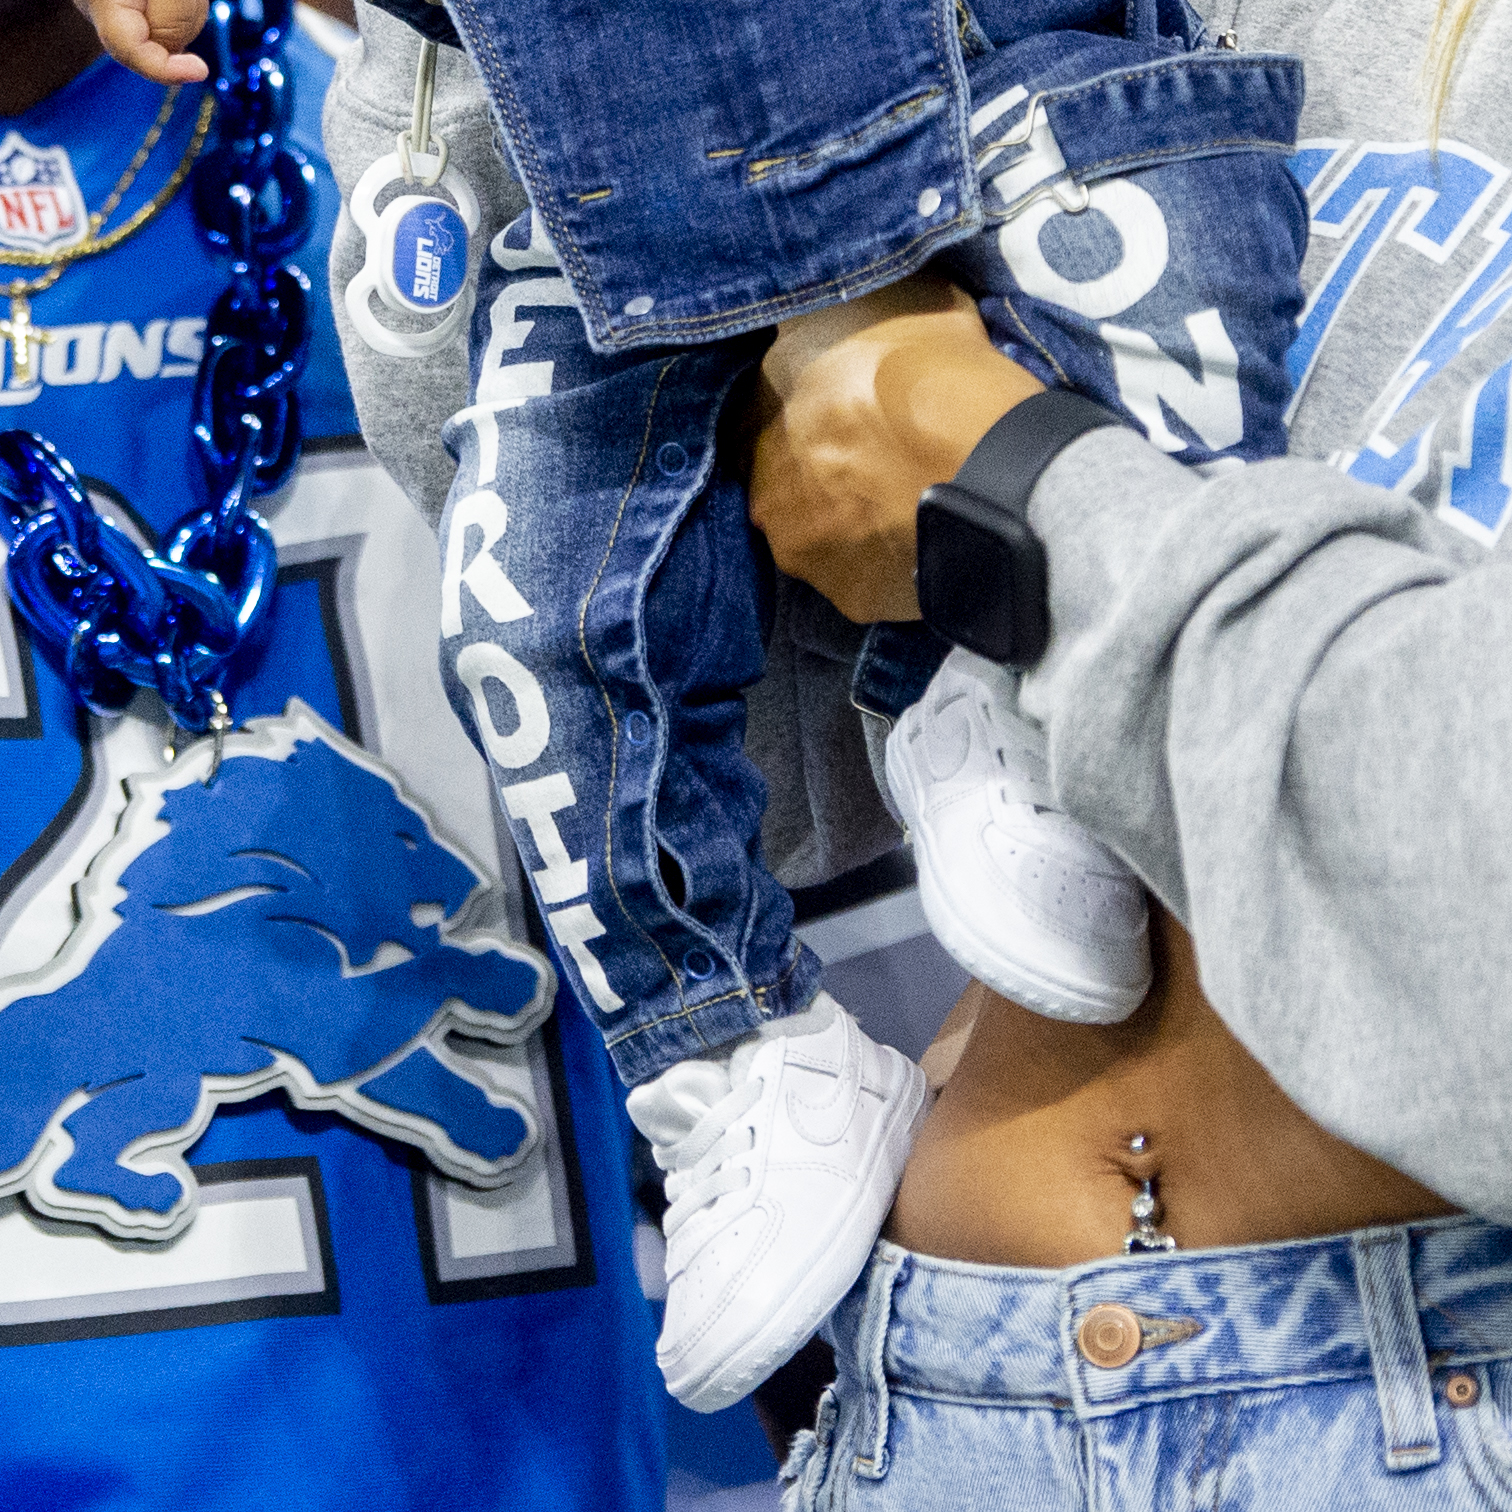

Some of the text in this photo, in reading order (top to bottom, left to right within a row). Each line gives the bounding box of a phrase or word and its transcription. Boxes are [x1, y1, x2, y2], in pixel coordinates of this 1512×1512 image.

[412, 236, 434, 300] LIONS
[428, 255, 442, 302] DETROIT
[970, 84, 1246, 478] ION
